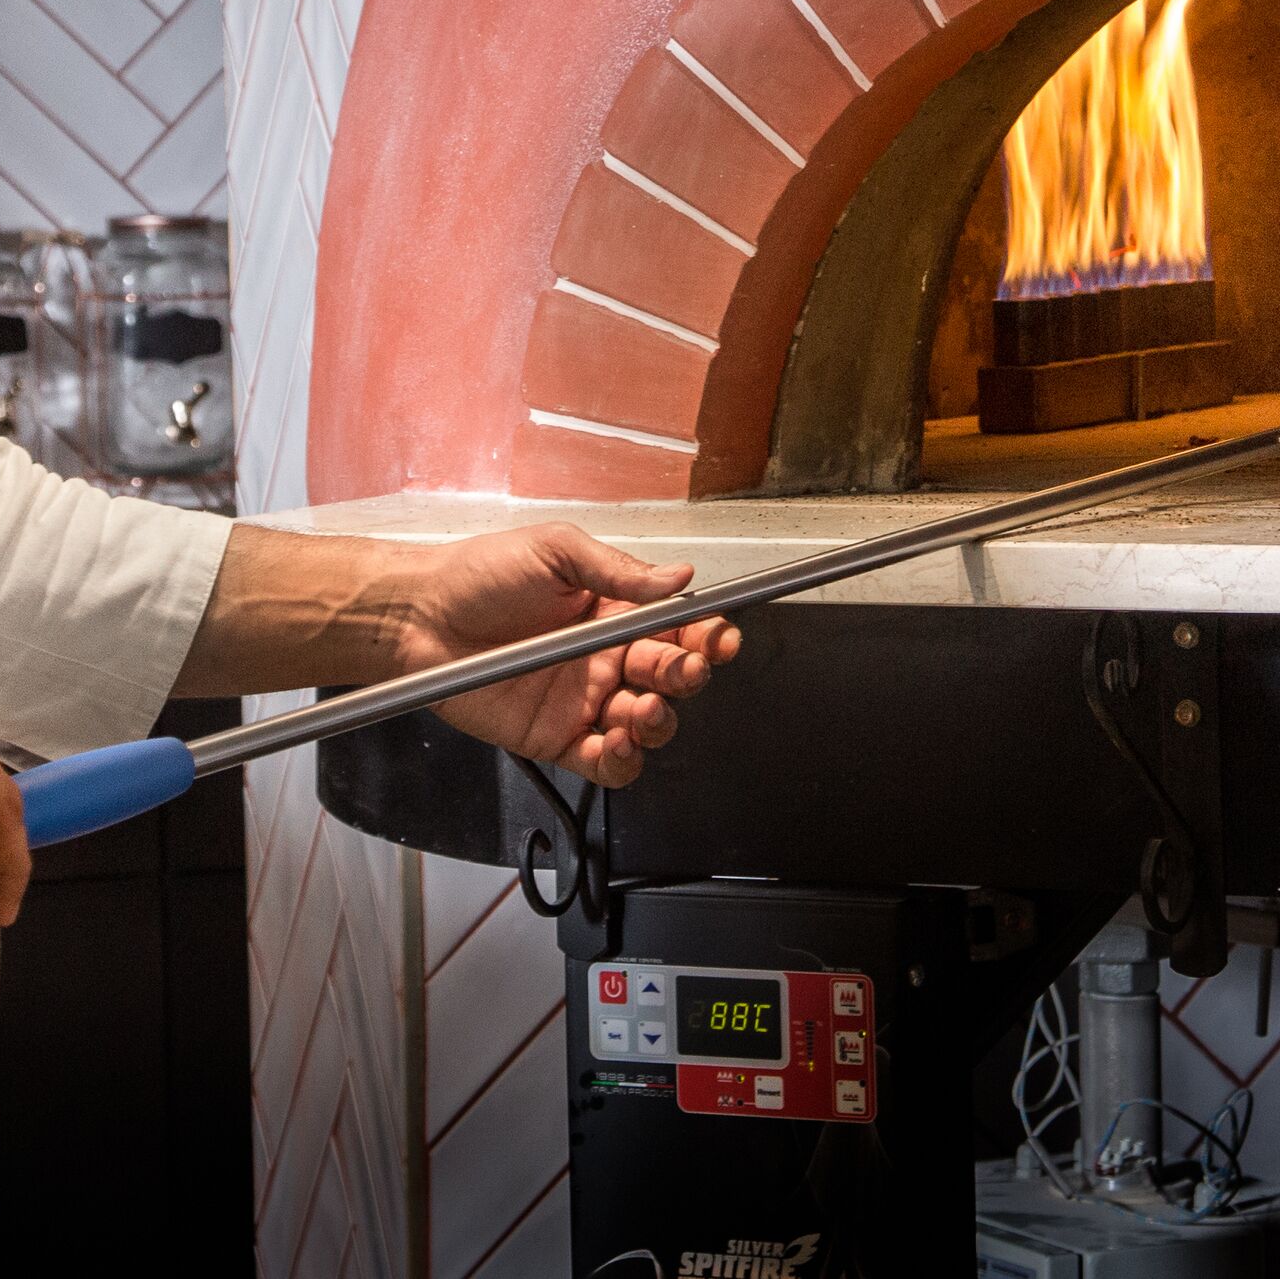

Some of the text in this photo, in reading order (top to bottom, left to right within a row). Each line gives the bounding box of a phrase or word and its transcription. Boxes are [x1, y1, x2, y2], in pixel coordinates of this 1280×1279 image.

[757, 1088, 781, 1097] Reset
[726, 1239, 786, 1257] SILVER
[678, 1251, 801, 1279] SPITFIRE
